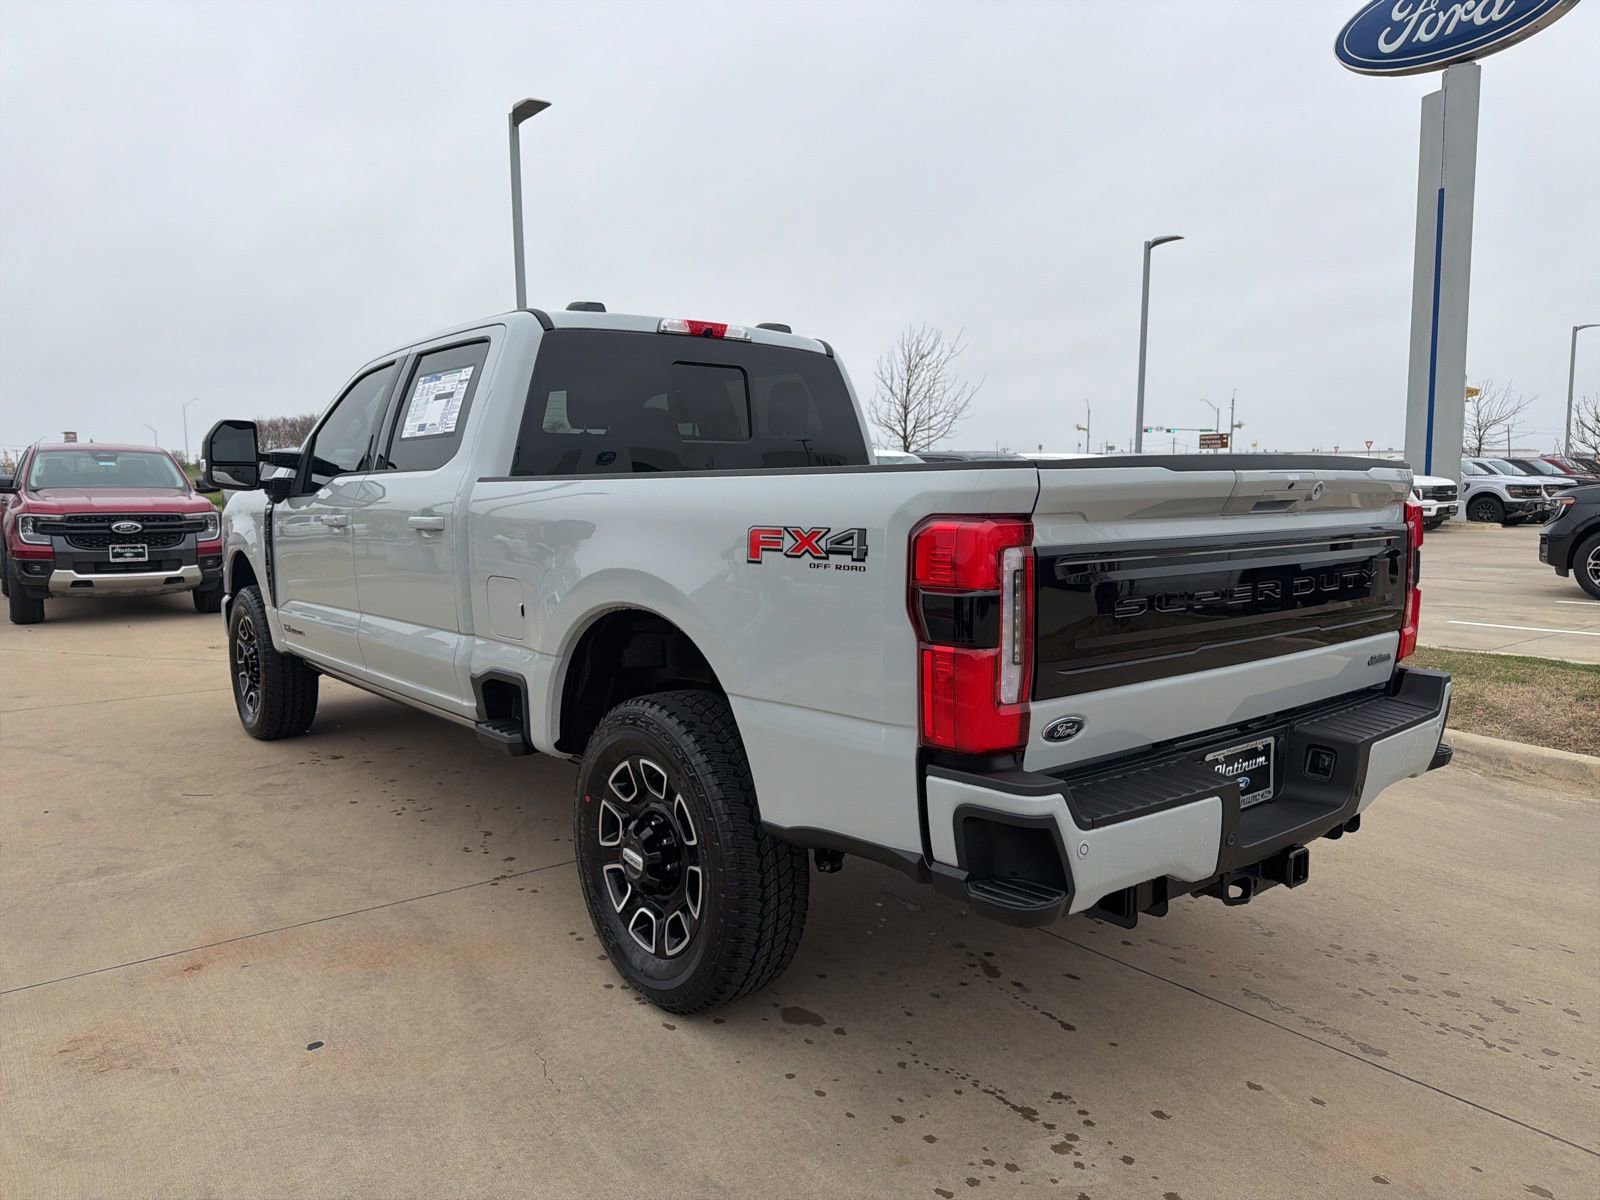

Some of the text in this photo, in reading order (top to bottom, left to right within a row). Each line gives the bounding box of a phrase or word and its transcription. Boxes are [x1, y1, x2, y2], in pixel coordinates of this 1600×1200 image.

[747, 525, 868, 564] FX4
[809, 562, 866, 572] OFF ROAD
[1114, 569, 1378, 618] SUPER DUTY
[1054, 722, 1078, 738] Ford
